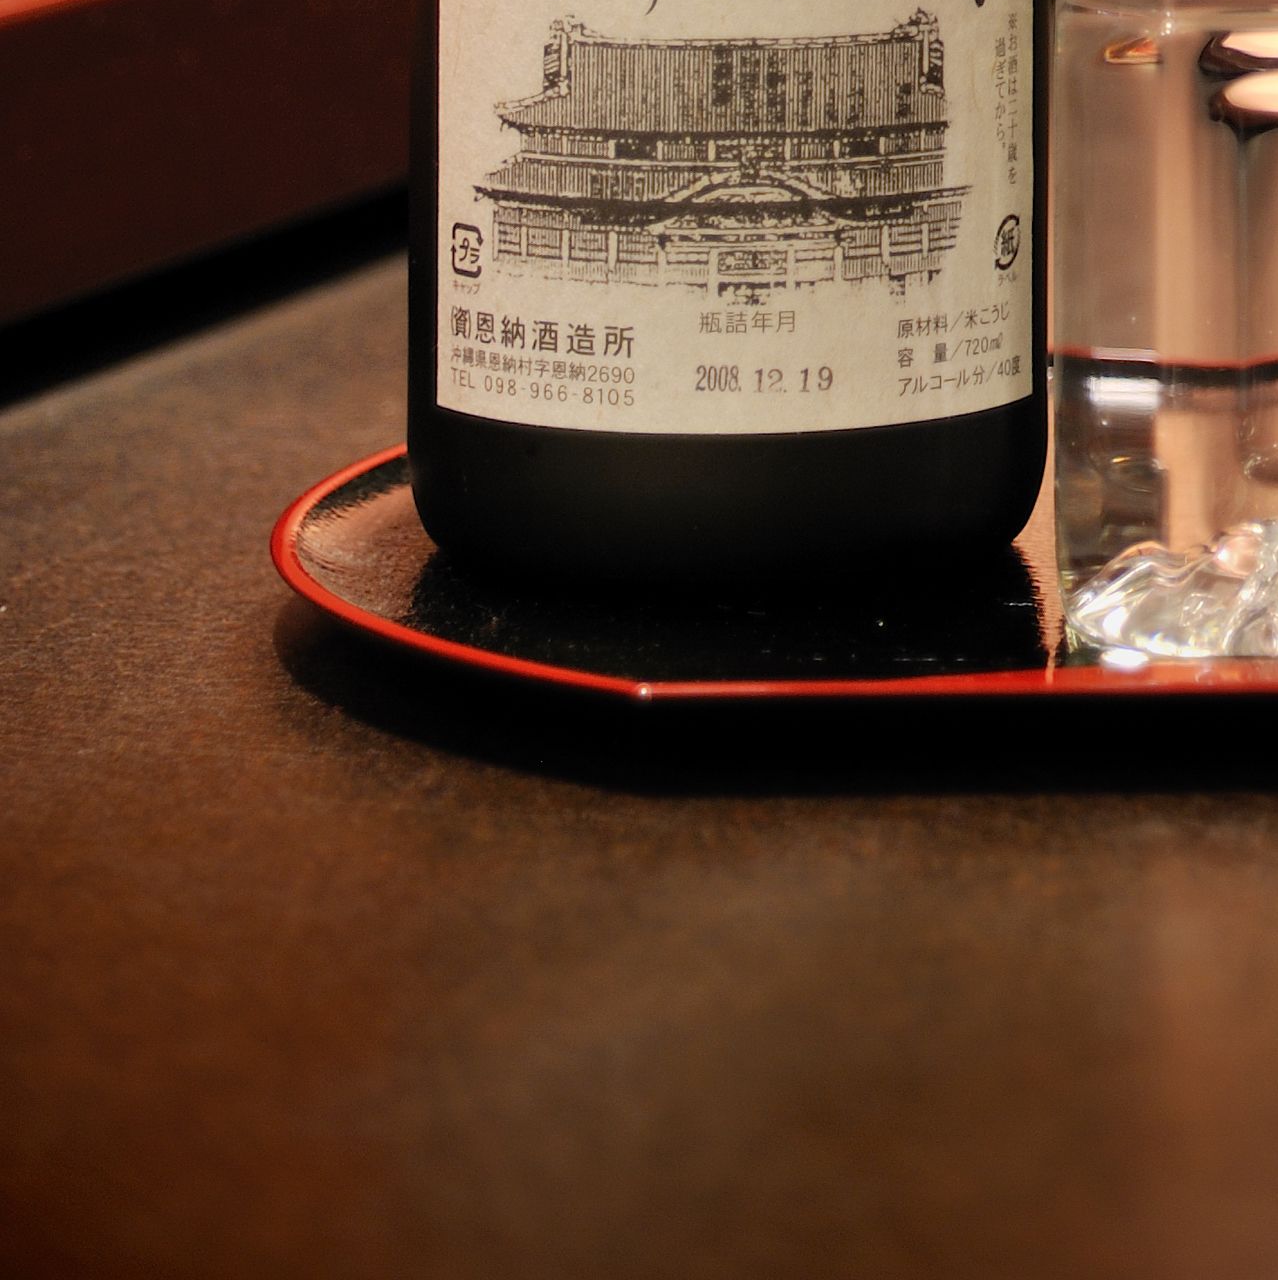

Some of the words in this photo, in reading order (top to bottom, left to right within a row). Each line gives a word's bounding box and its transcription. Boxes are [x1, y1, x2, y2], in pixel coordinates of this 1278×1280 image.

[698, 310, 797, 335] 瓶詰年月
[450, 366, 477, 390] TEL
[484, 374, 636, 407] 098-966-8105
